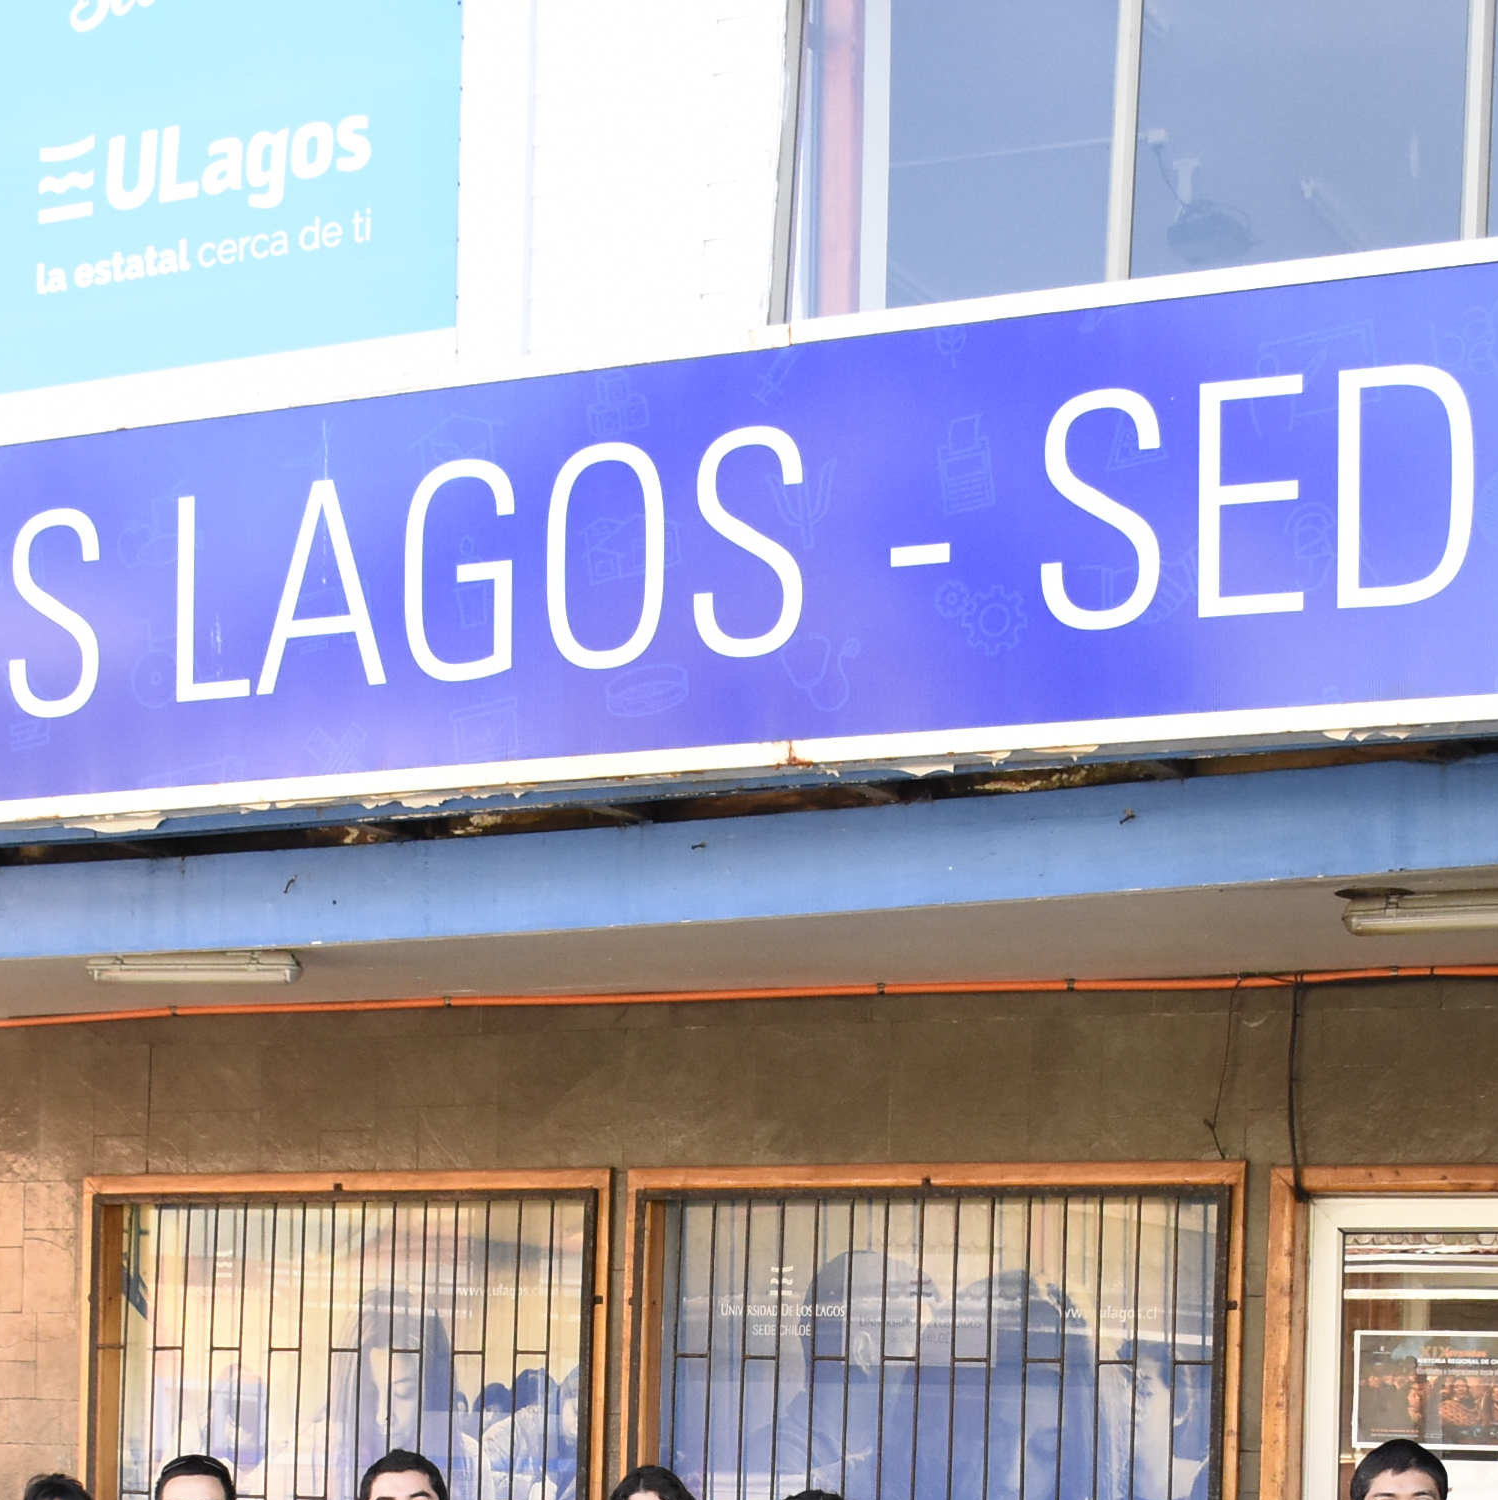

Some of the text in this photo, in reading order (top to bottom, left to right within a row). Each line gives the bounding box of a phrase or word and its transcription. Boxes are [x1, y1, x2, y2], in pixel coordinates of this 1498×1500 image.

[105, 114, 372, 210] ULagos
[36, 207, 371, 294] la estatal cerca de ti
[176, 425, 803, 703] LAGOS
[721, 1304, 778, 1316] UNIVRSIDAD
[815, 1304, 845, 1317] LAGOS
[753, 1324, 776, 1336] SEDE
